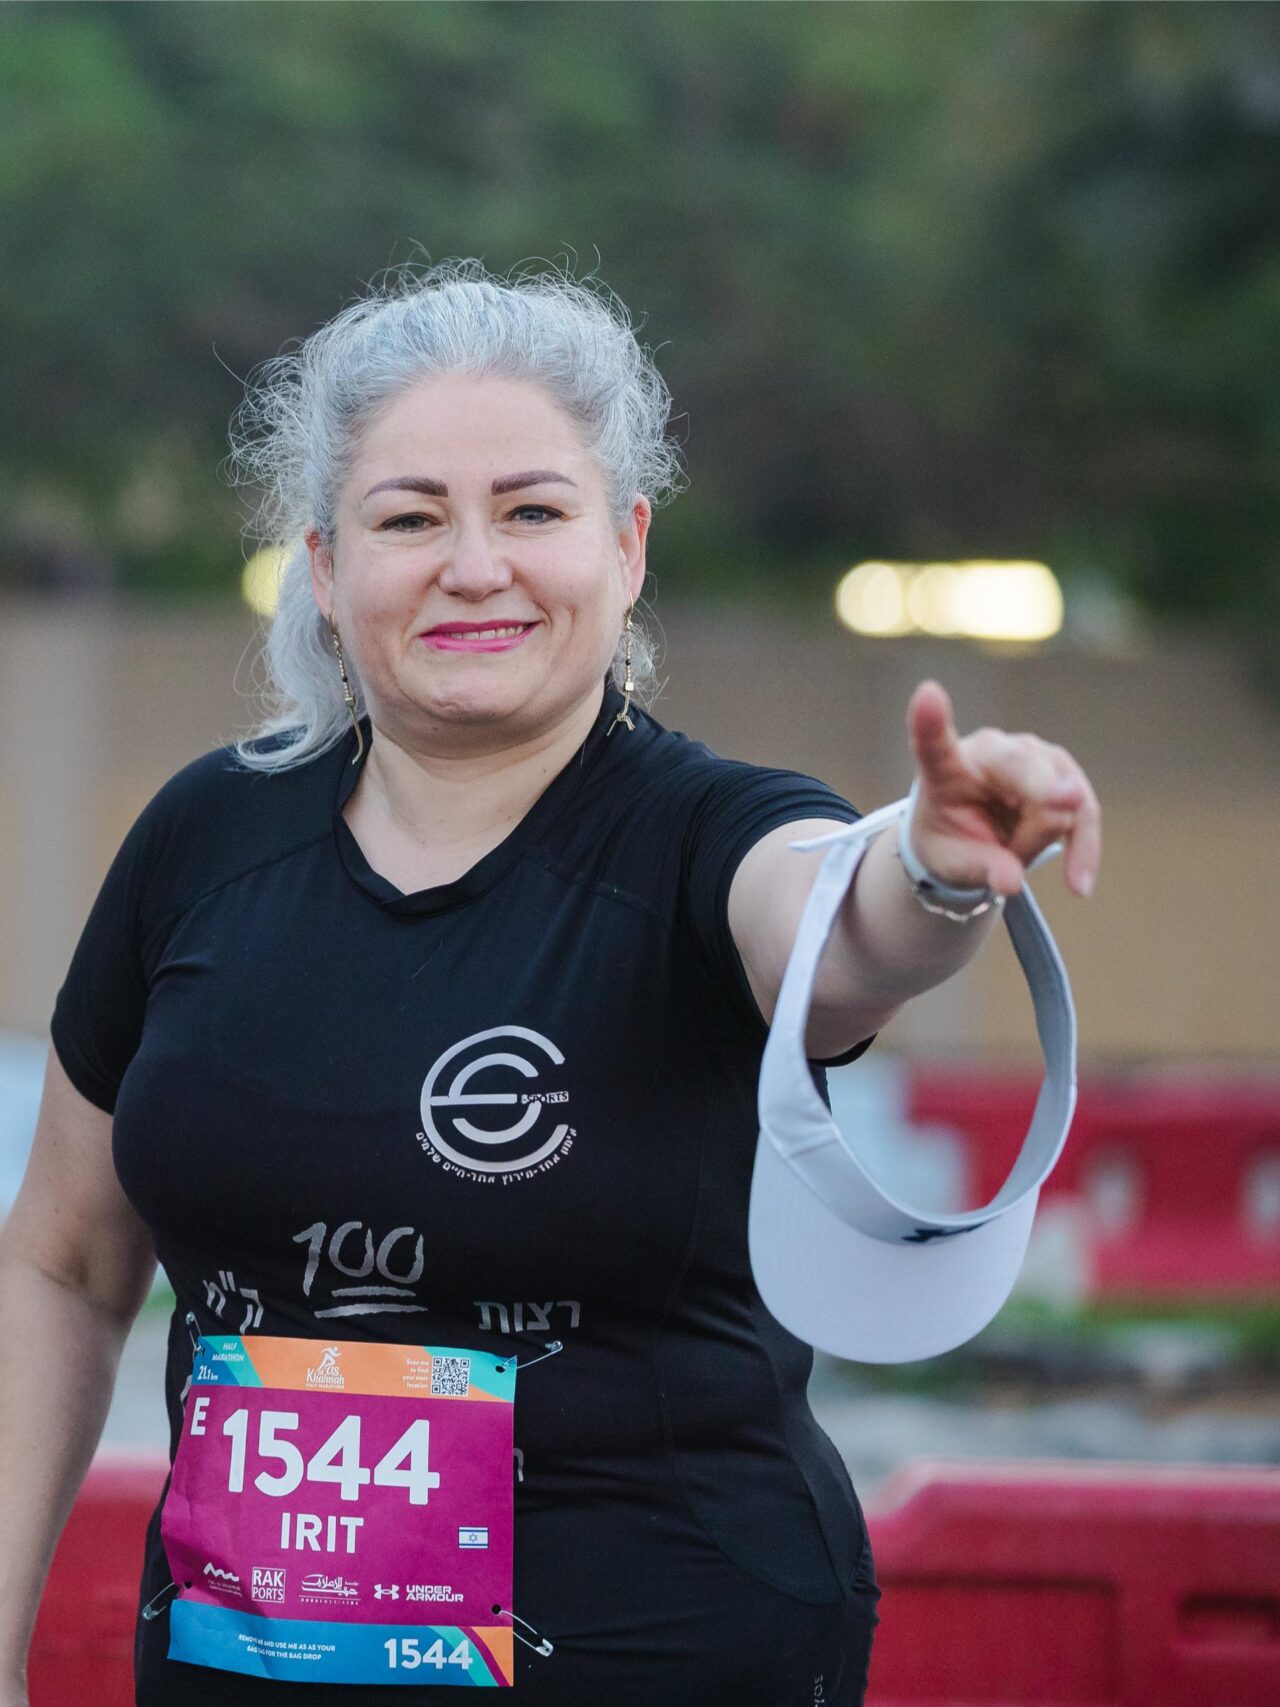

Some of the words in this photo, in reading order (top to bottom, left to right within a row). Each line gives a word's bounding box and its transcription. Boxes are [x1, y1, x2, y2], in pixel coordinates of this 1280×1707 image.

[292, 1221, 424, 1296] 100
[473, 1301, 580, 1334] רצות
[222, 1342, 238, 1350] HALF
[211, 1353, 244, 1362] MARATHON
[190, 1397, 210, 1436] E
[223, 1408, 440, 1505] 1544
[280, 1512, 364, 1554] IRIT
[253, 1569, 284, 1587] RAK
[252, 1587, 284, 1601] PORTS
[406, 1584, 452, 1594] UNDER
[406, 1593, 464, 1602] ARMOUR
[247, 1645, 258, 1653] BAG
[263, 1640, 274, 1648] AND
[275, 1641, 287, 1649] USE
[317, 1644, 336, 1652] YOUR
[384, 1638, 473, 1670] 1544
